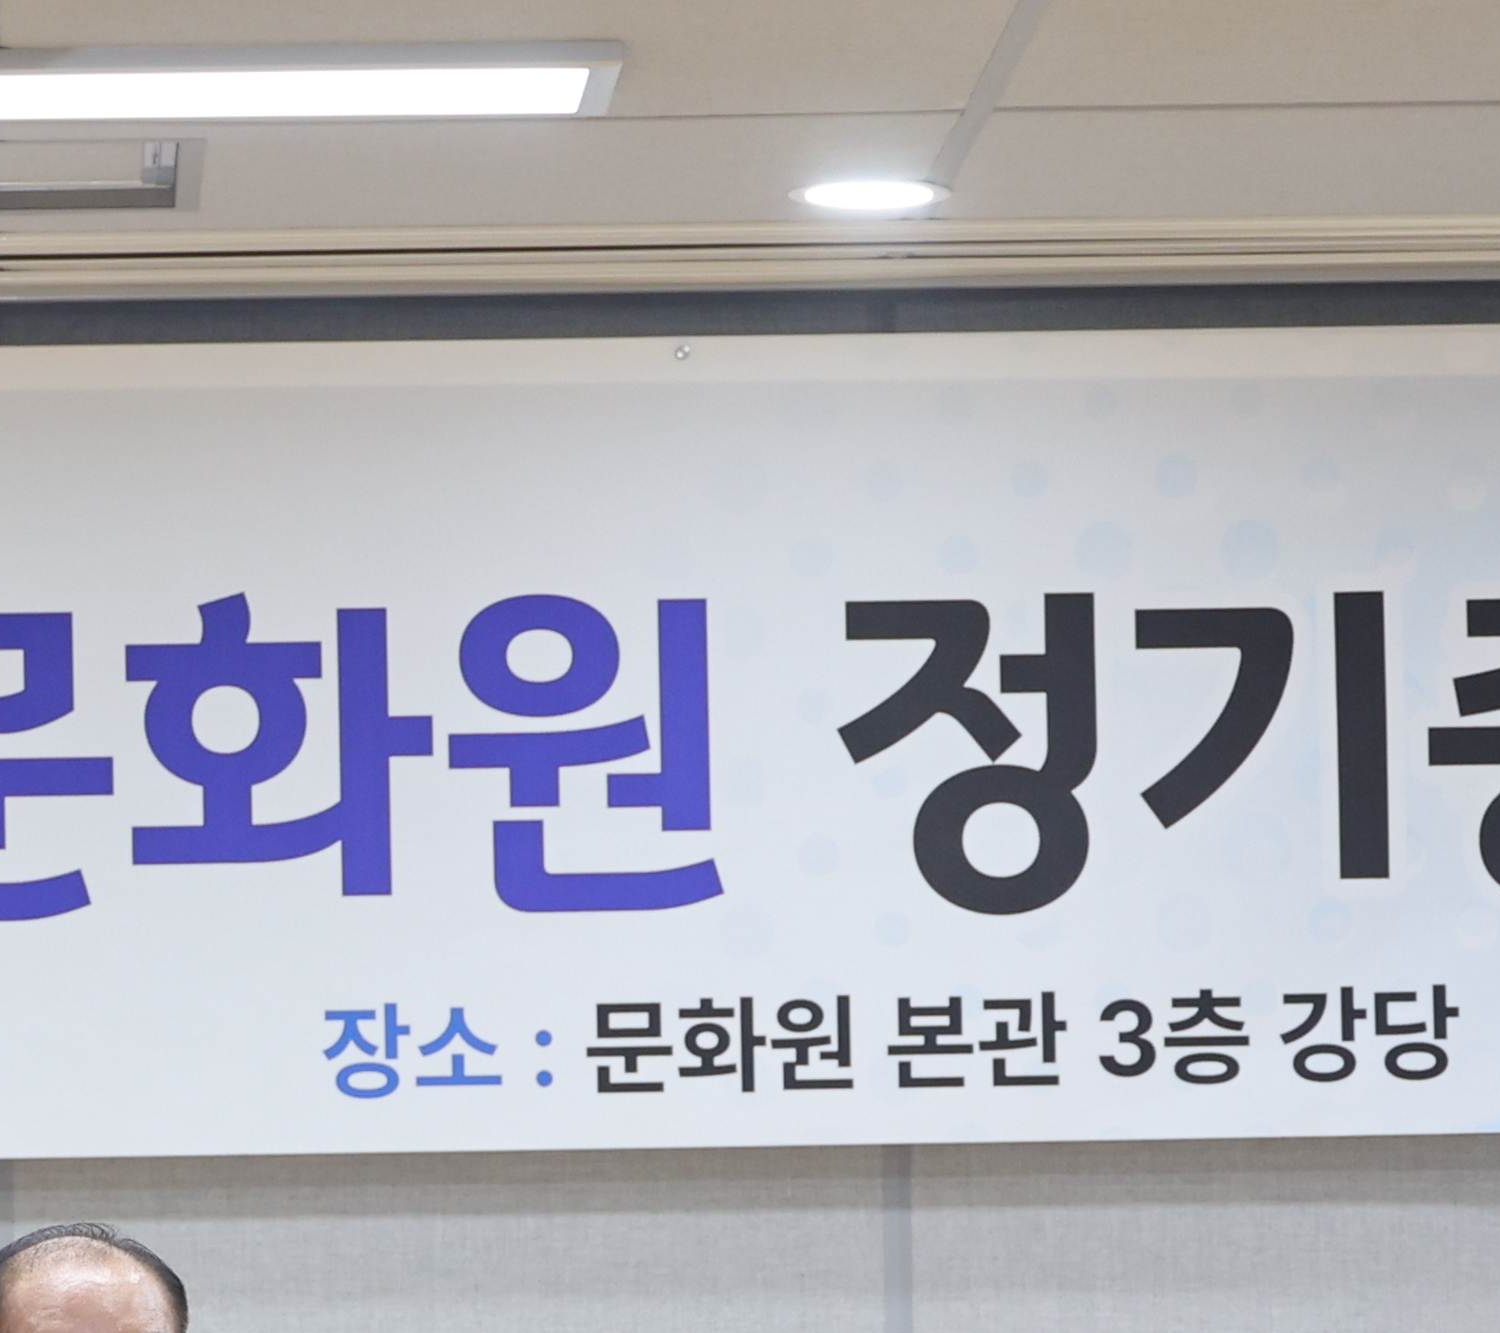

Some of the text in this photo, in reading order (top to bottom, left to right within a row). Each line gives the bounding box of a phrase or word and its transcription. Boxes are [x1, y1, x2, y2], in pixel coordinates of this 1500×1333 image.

[586, 994, 854, 1094] 문화원
[887, 991, 1068, 1089] 본관
[1098, 988, 1250, 1085] 3층
[1278, 984, 1460, 1083] 강당
